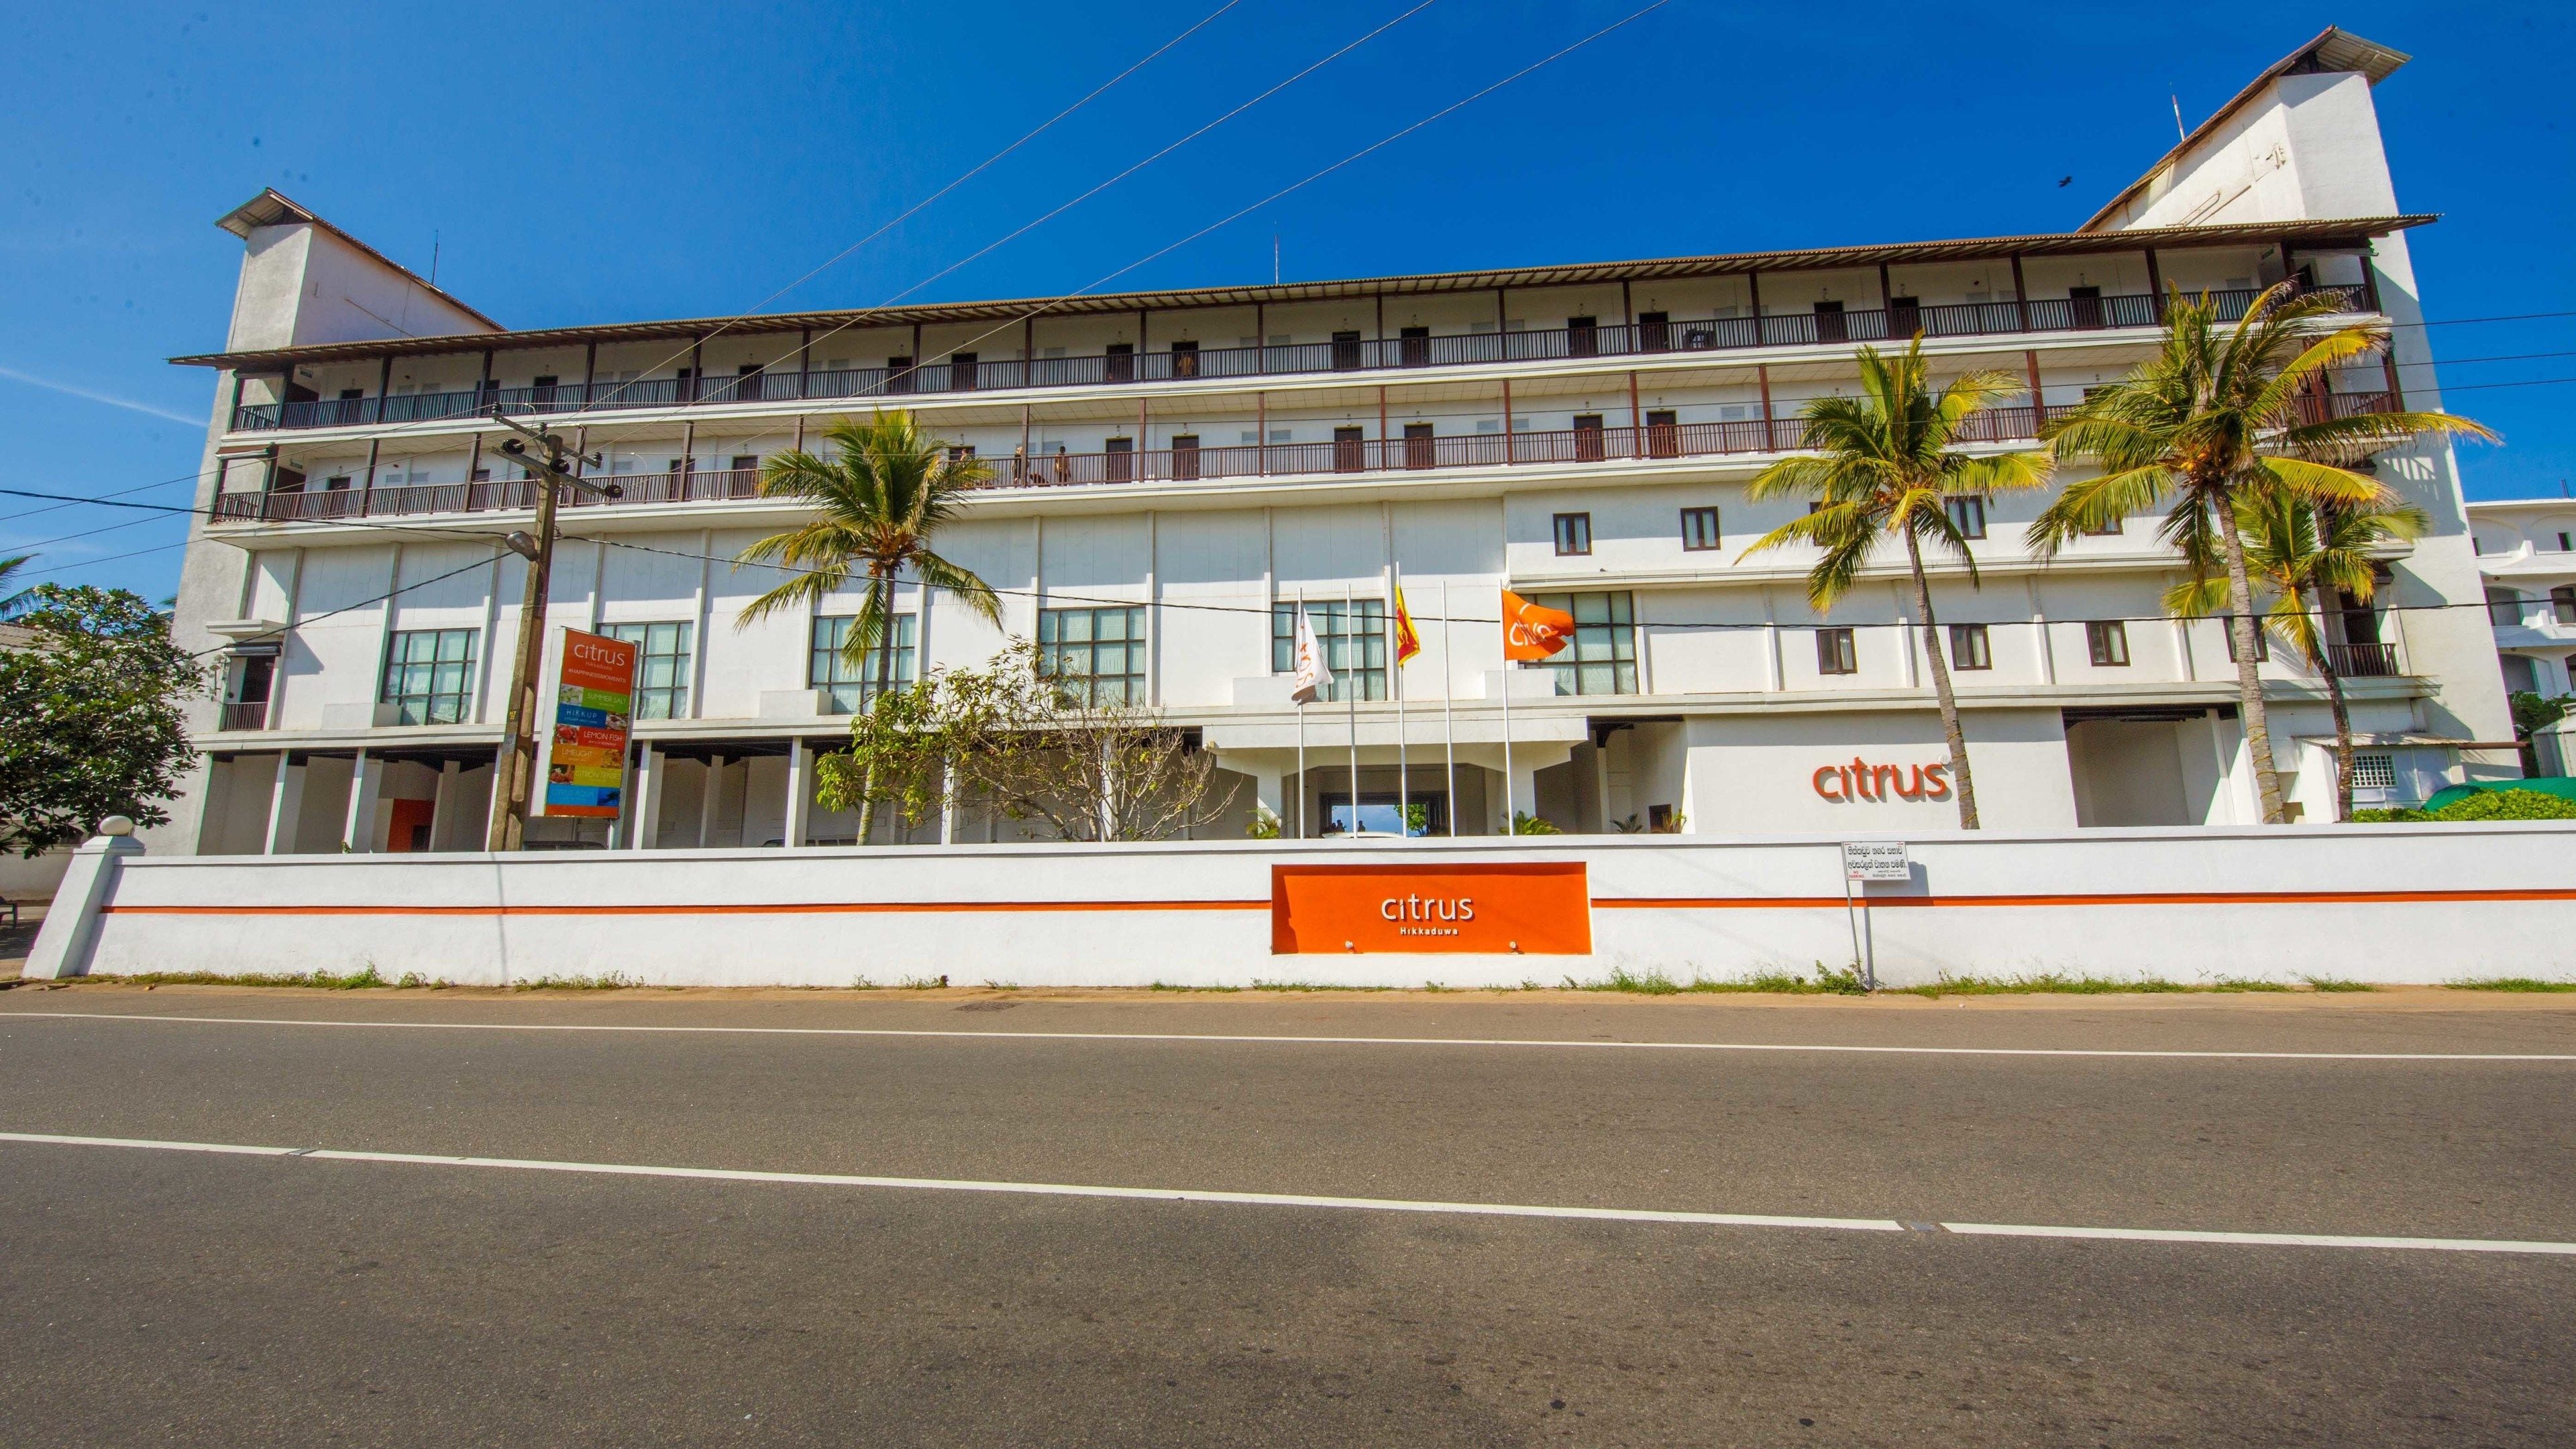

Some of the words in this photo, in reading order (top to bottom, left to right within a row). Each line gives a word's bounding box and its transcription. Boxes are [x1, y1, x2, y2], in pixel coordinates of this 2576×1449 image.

[574, 643, 625, 666] citrus
[587, 692, 612, 702] SUMMER
[612, 696, 627, 704] SALT
[566, 708, 597, 718] HIKKUP
[583, 731, 608, 740] LEMON
[561, 748, 593, 757] LIMELIGHT
[1812, 757, 1947, 798] citrus
[1381, 893, 1474, 920] citrus
[1400, 927, 1458, 936] Hikkaduwa
